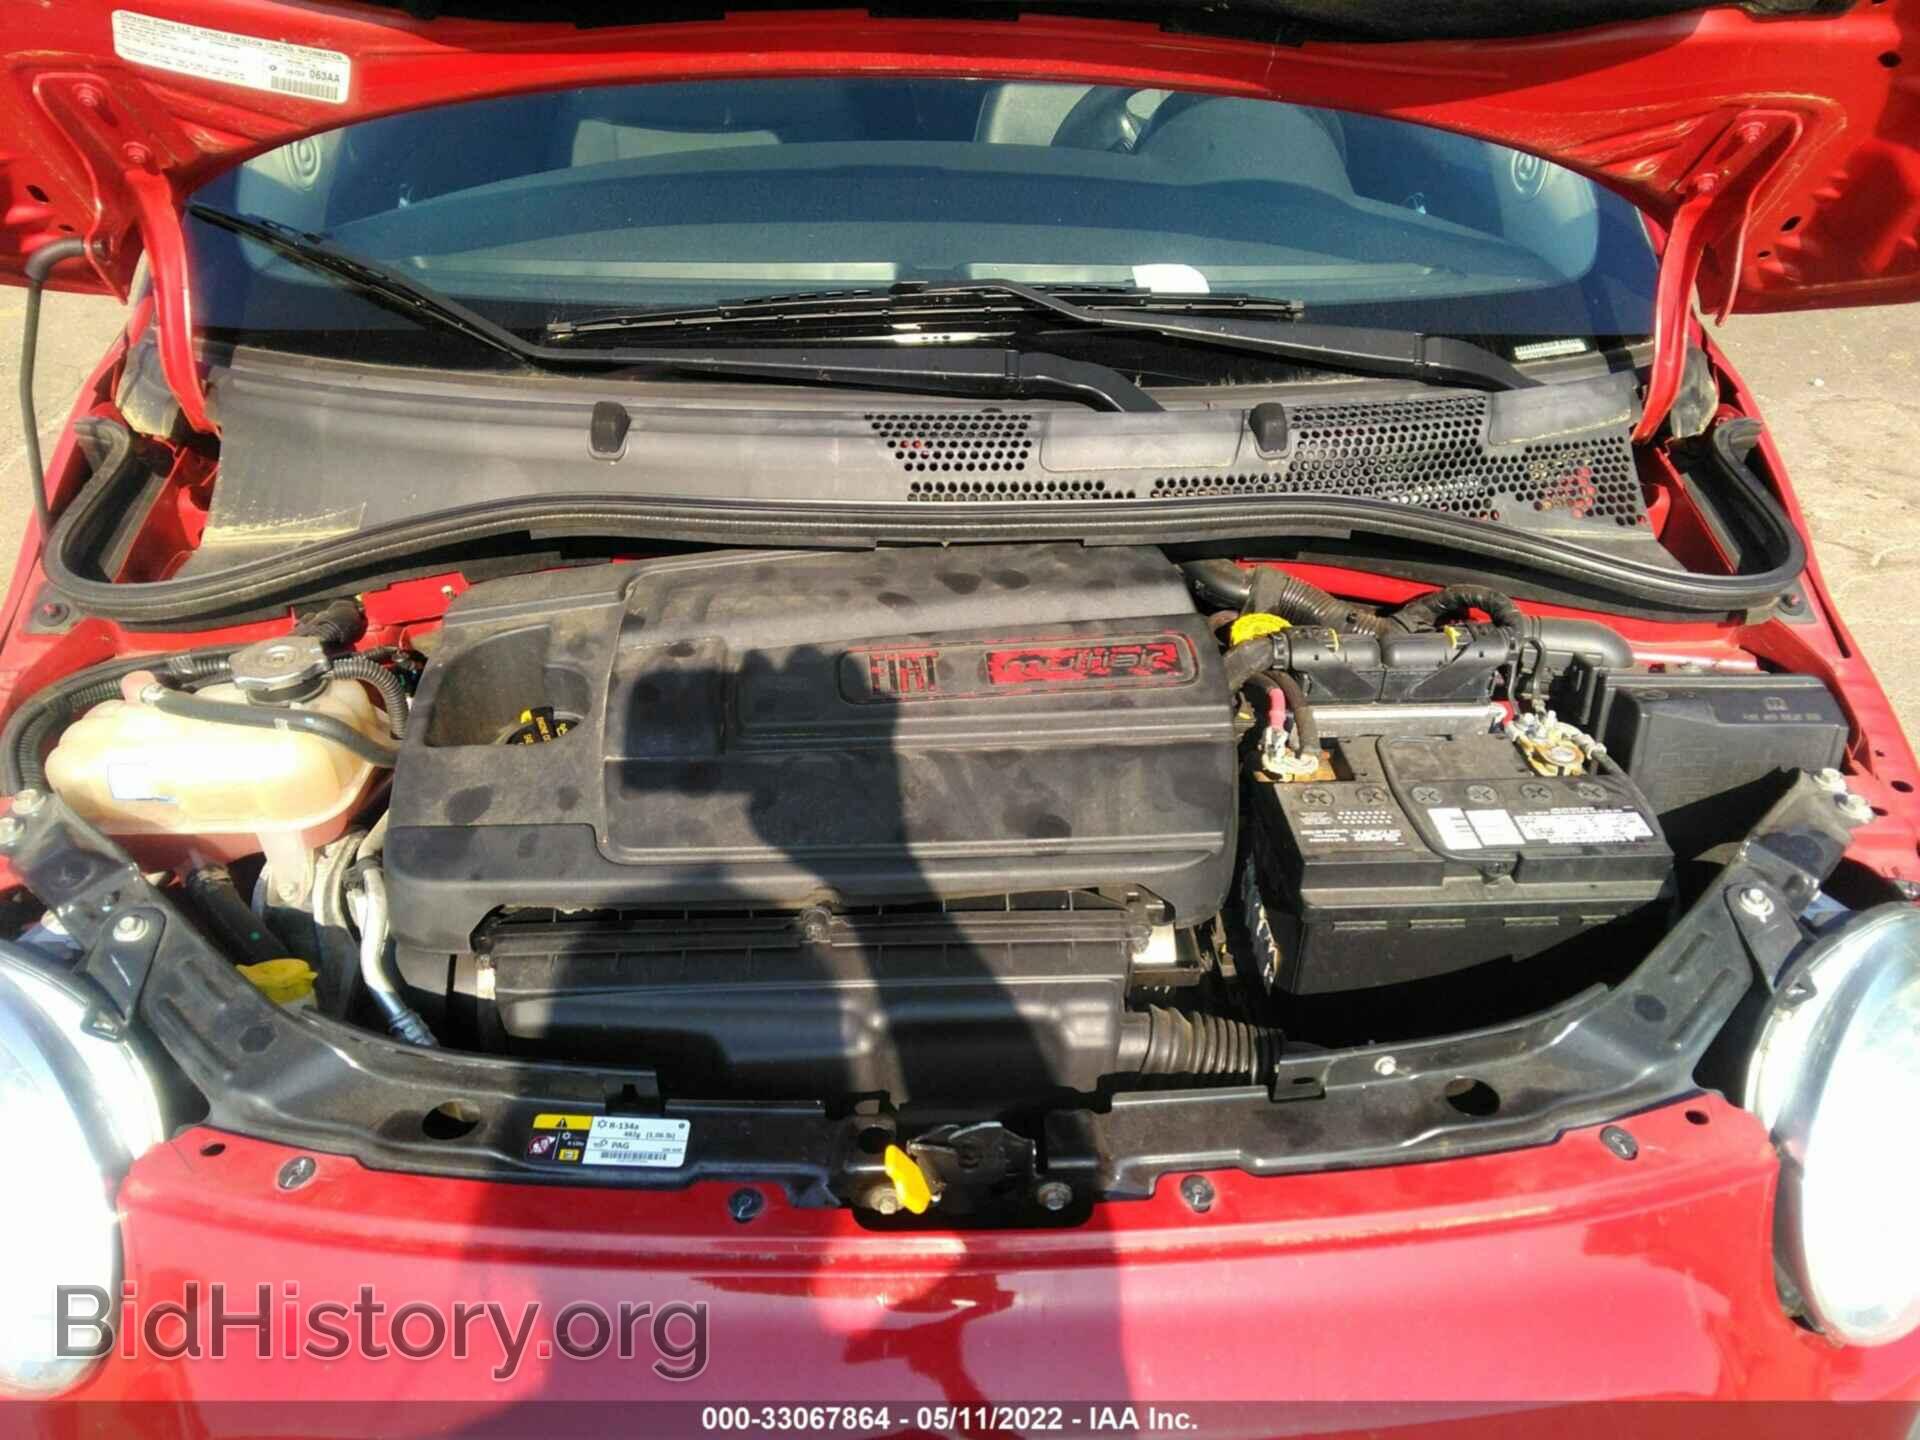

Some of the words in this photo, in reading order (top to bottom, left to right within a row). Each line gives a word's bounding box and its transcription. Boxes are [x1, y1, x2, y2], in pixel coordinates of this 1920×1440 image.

[308, 69, 341, 82] 063AA
[869, 651, 940, 695] FIAT
[611, 1141, 630, 1149] PAG
